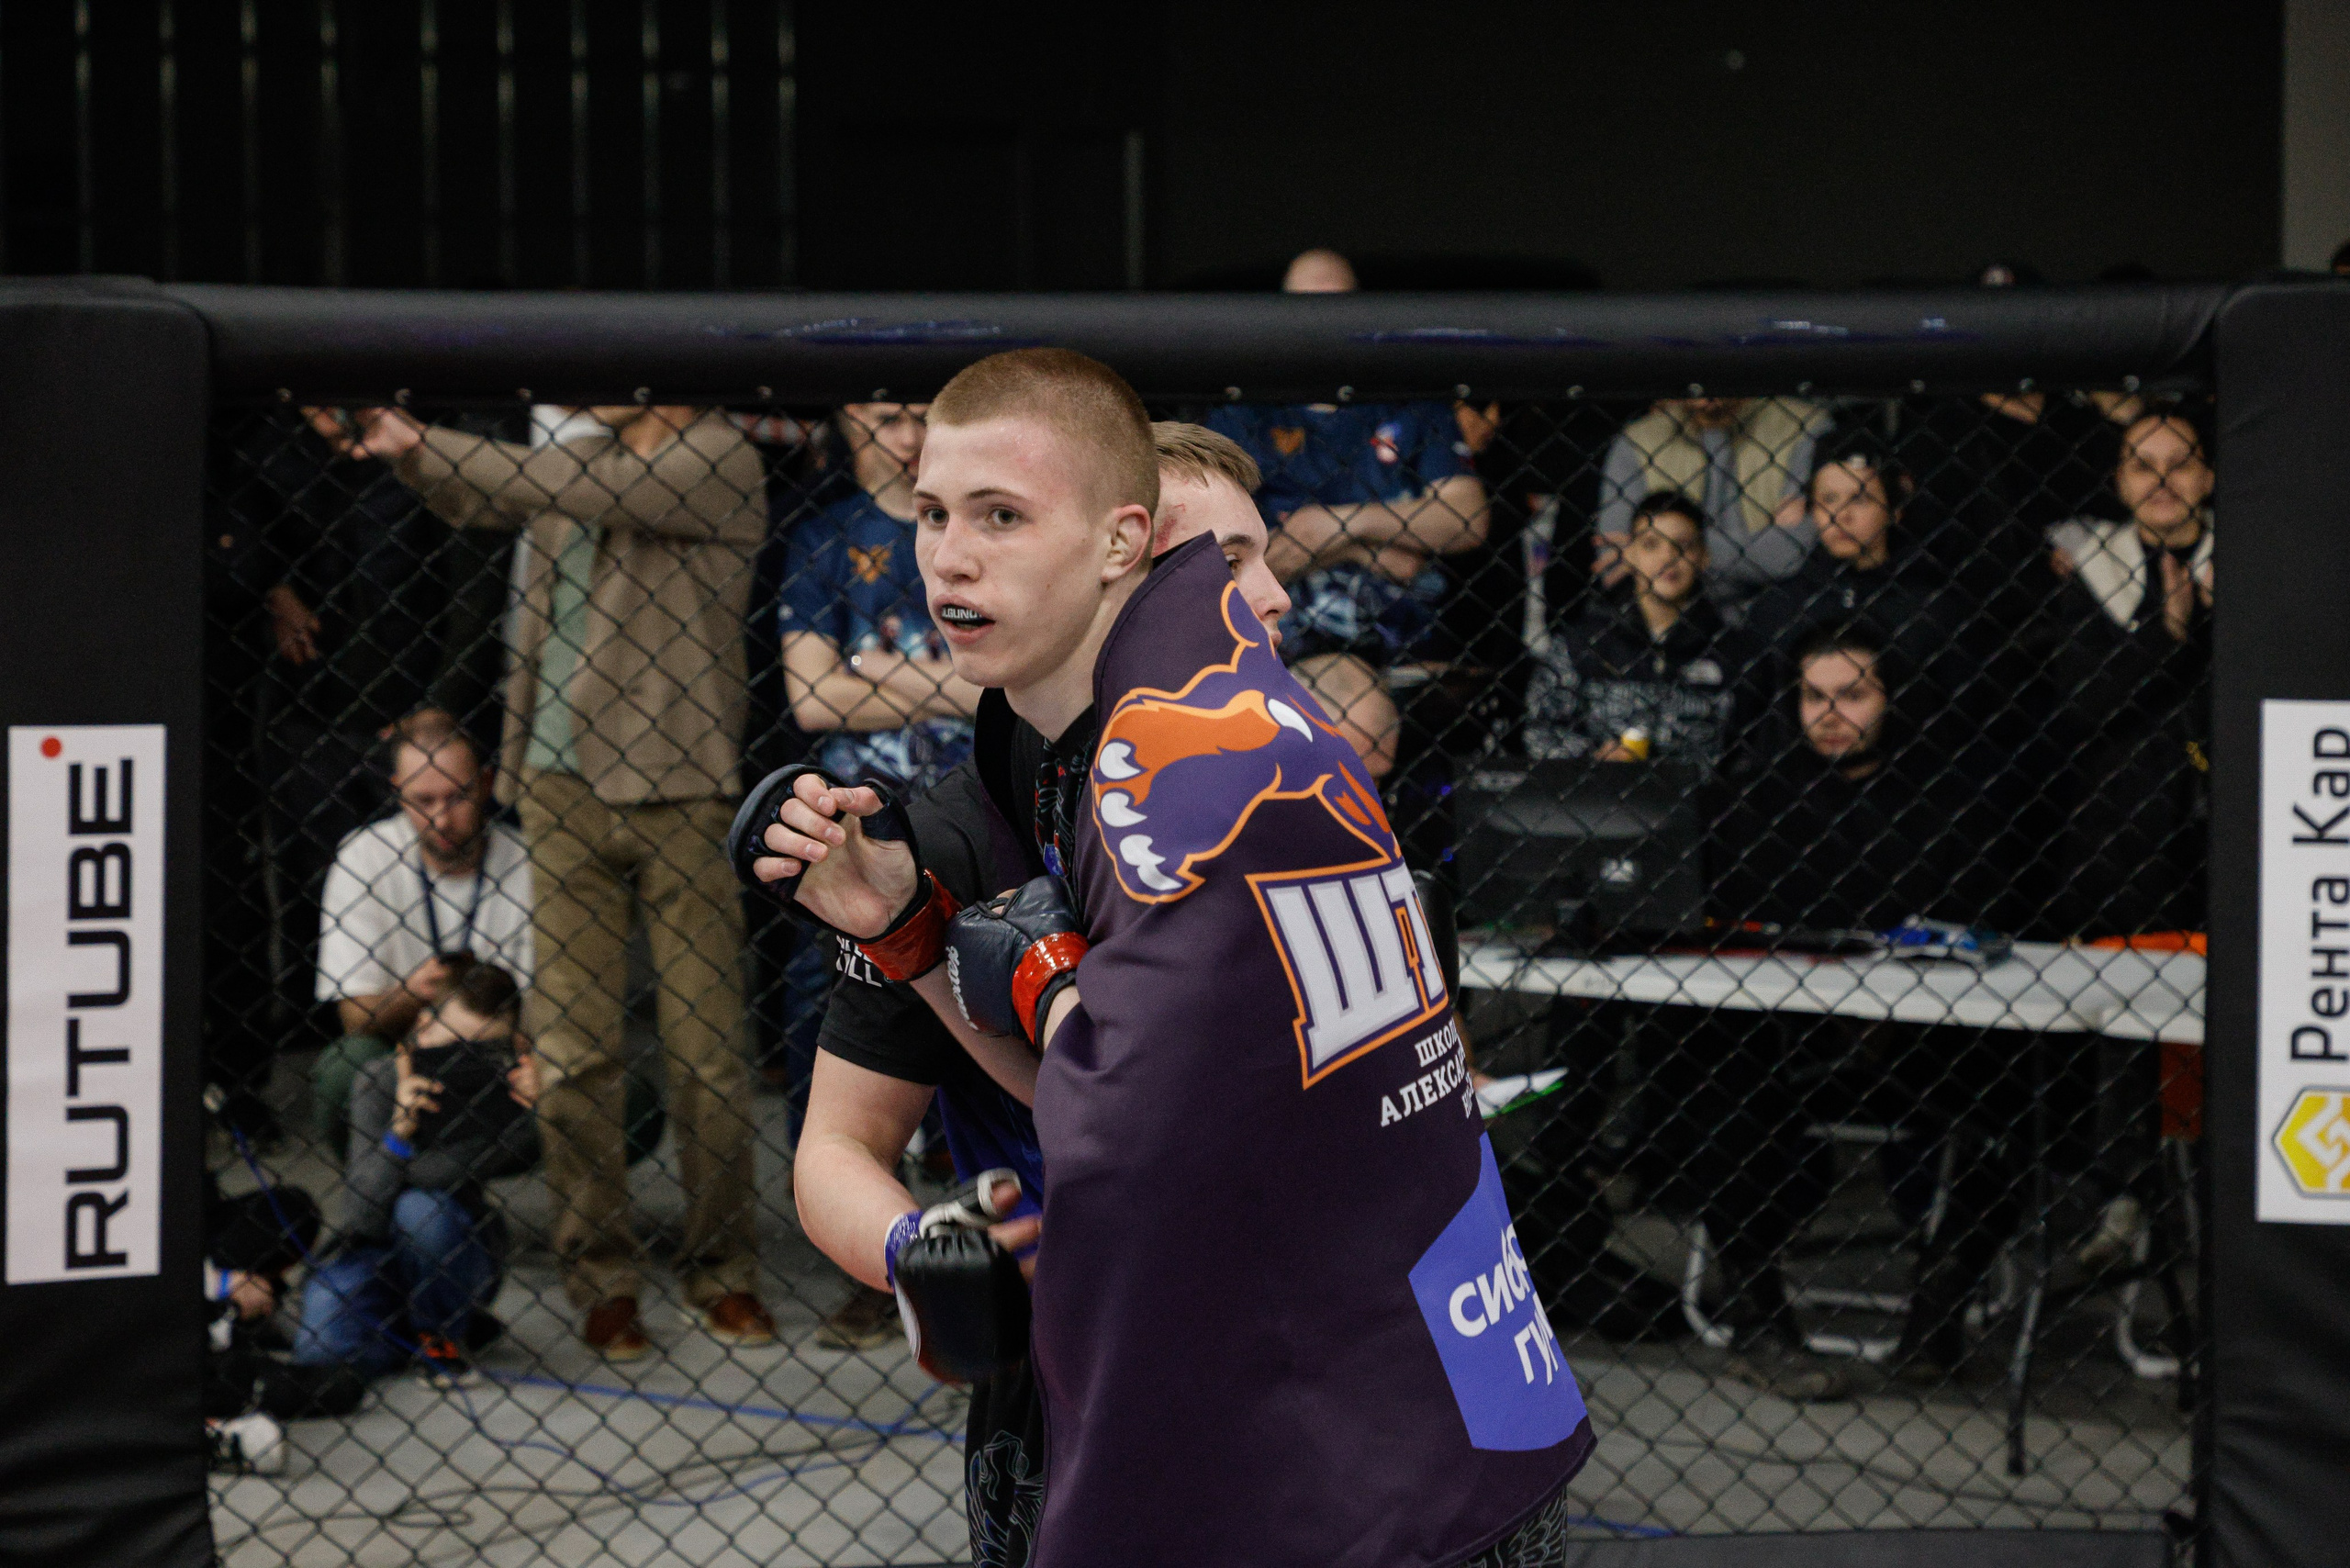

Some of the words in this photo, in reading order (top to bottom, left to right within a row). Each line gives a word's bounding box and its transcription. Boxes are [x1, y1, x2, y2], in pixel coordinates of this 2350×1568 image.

[2291, 727, 2350, 846] Кар
[65, 757, 133, 1271] RUTUBE
[2290, 874, 2350, 1062] Рента
